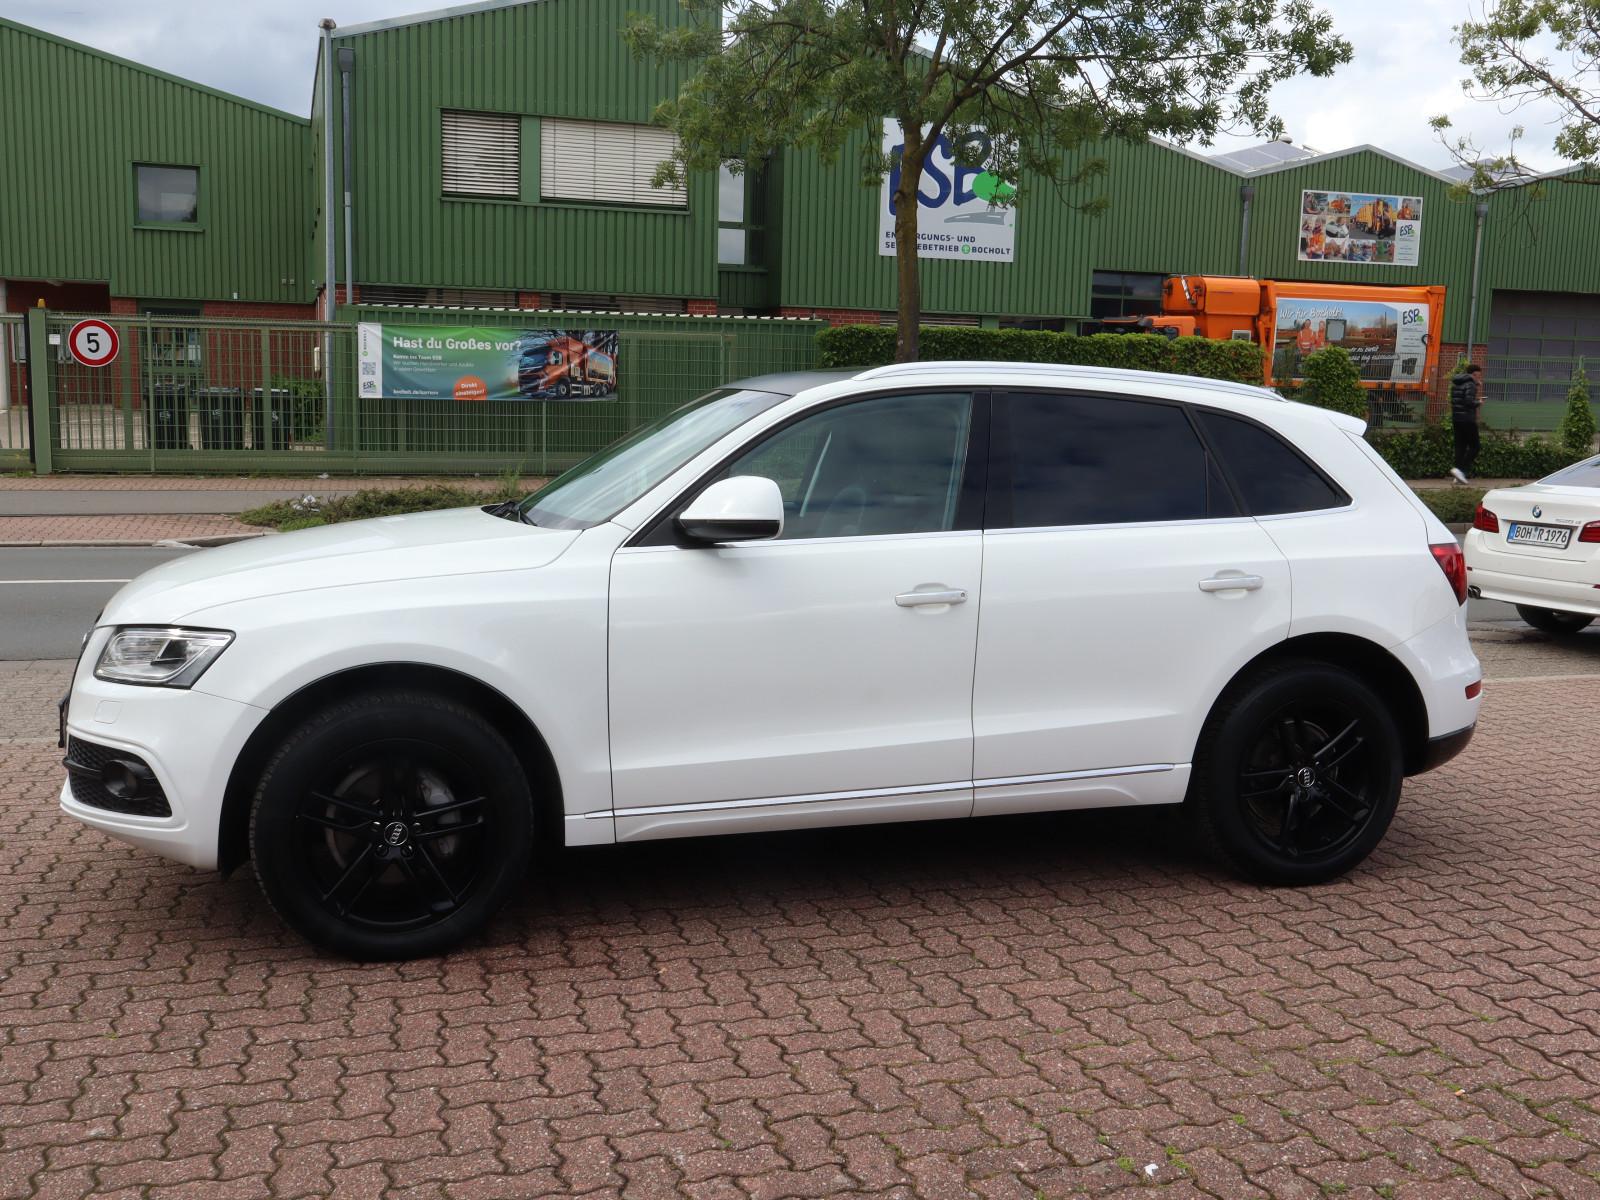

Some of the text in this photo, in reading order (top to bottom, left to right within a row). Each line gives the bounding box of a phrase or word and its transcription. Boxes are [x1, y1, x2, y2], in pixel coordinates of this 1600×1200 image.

[885, 231, 976, 243] ENRGUNGS- UND
[885, 242, 1011, 255] SEEBETRIEB BOCHOLT
[86, 332, 100, 353] 5
[393, 336, 522, 351] Hast du Großes vor?
[1515, 526, 1568, 543] BOH R 1976
